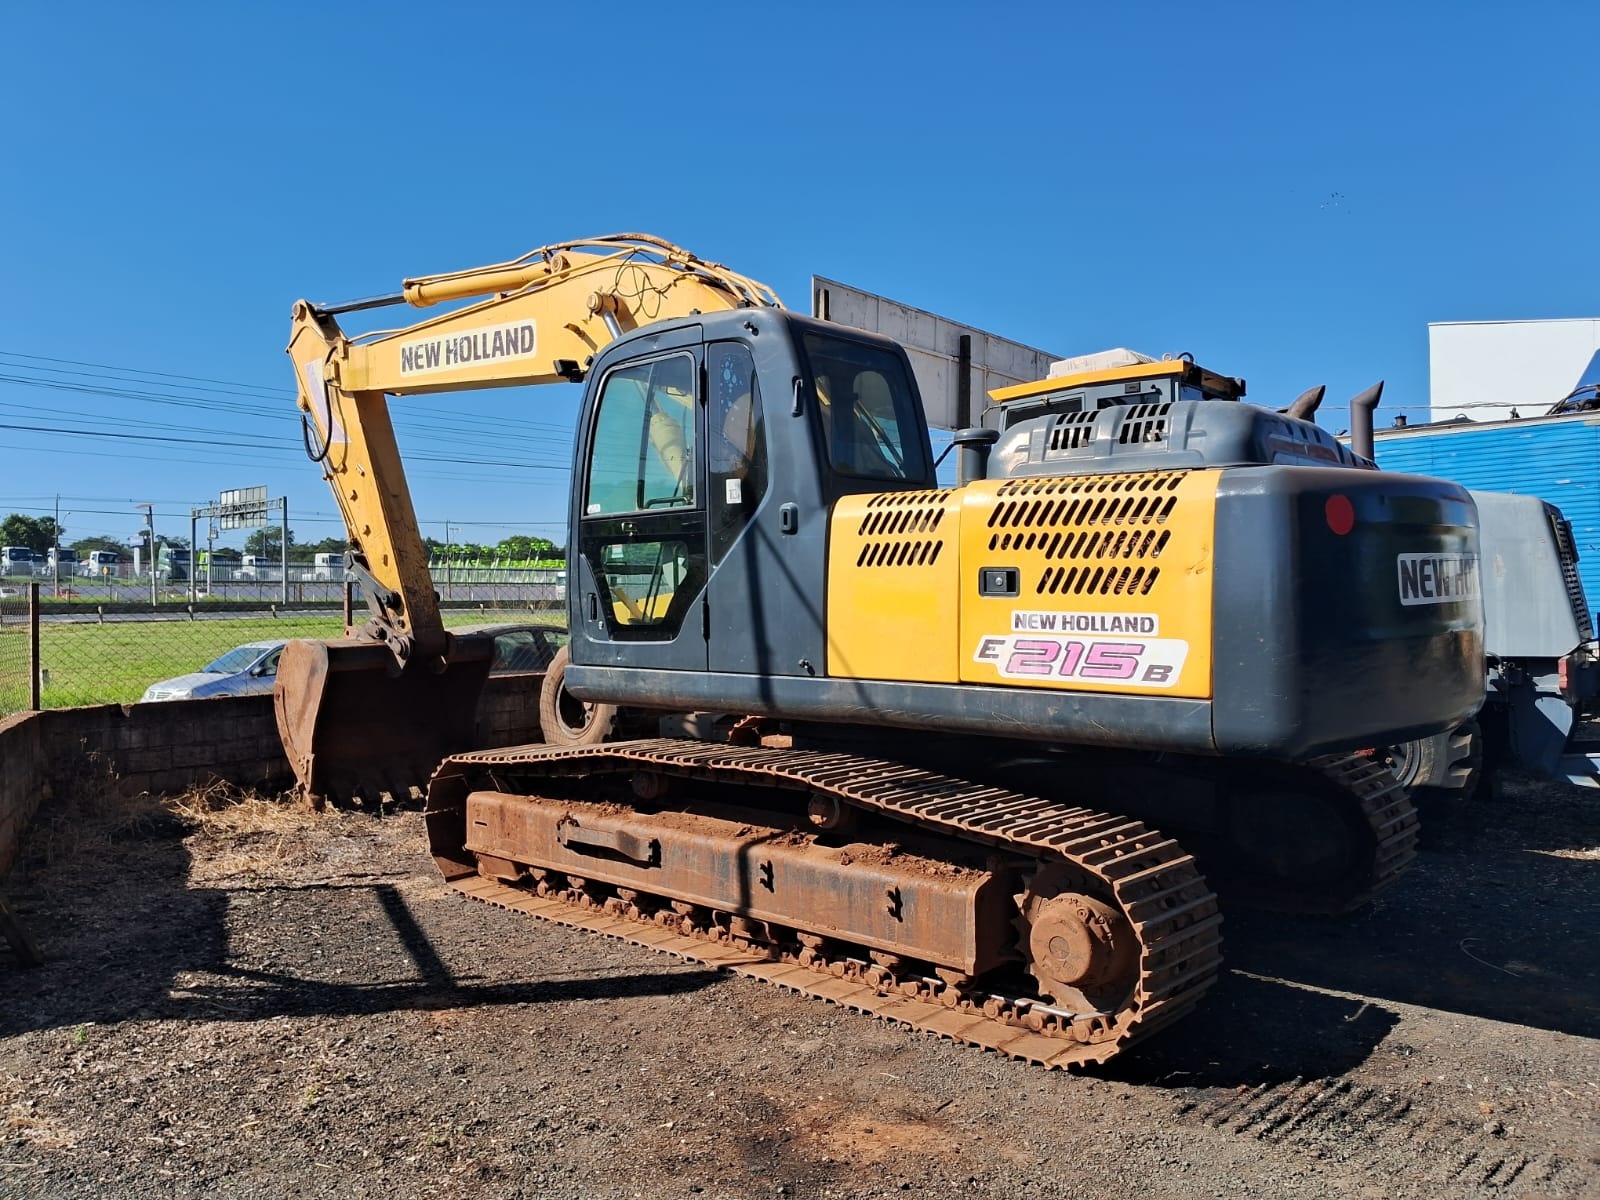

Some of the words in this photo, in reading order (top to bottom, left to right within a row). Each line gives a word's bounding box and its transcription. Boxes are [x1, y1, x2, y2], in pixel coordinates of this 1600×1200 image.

[401, 341, 441, 373] NEW
[445, 324, 535, 366] HOLLAND
[1400, 559, 1450, 599] NEW
[1014, 613, 1057, 630] NEW
[1061, 614, 1155, 633] HOLLAND
